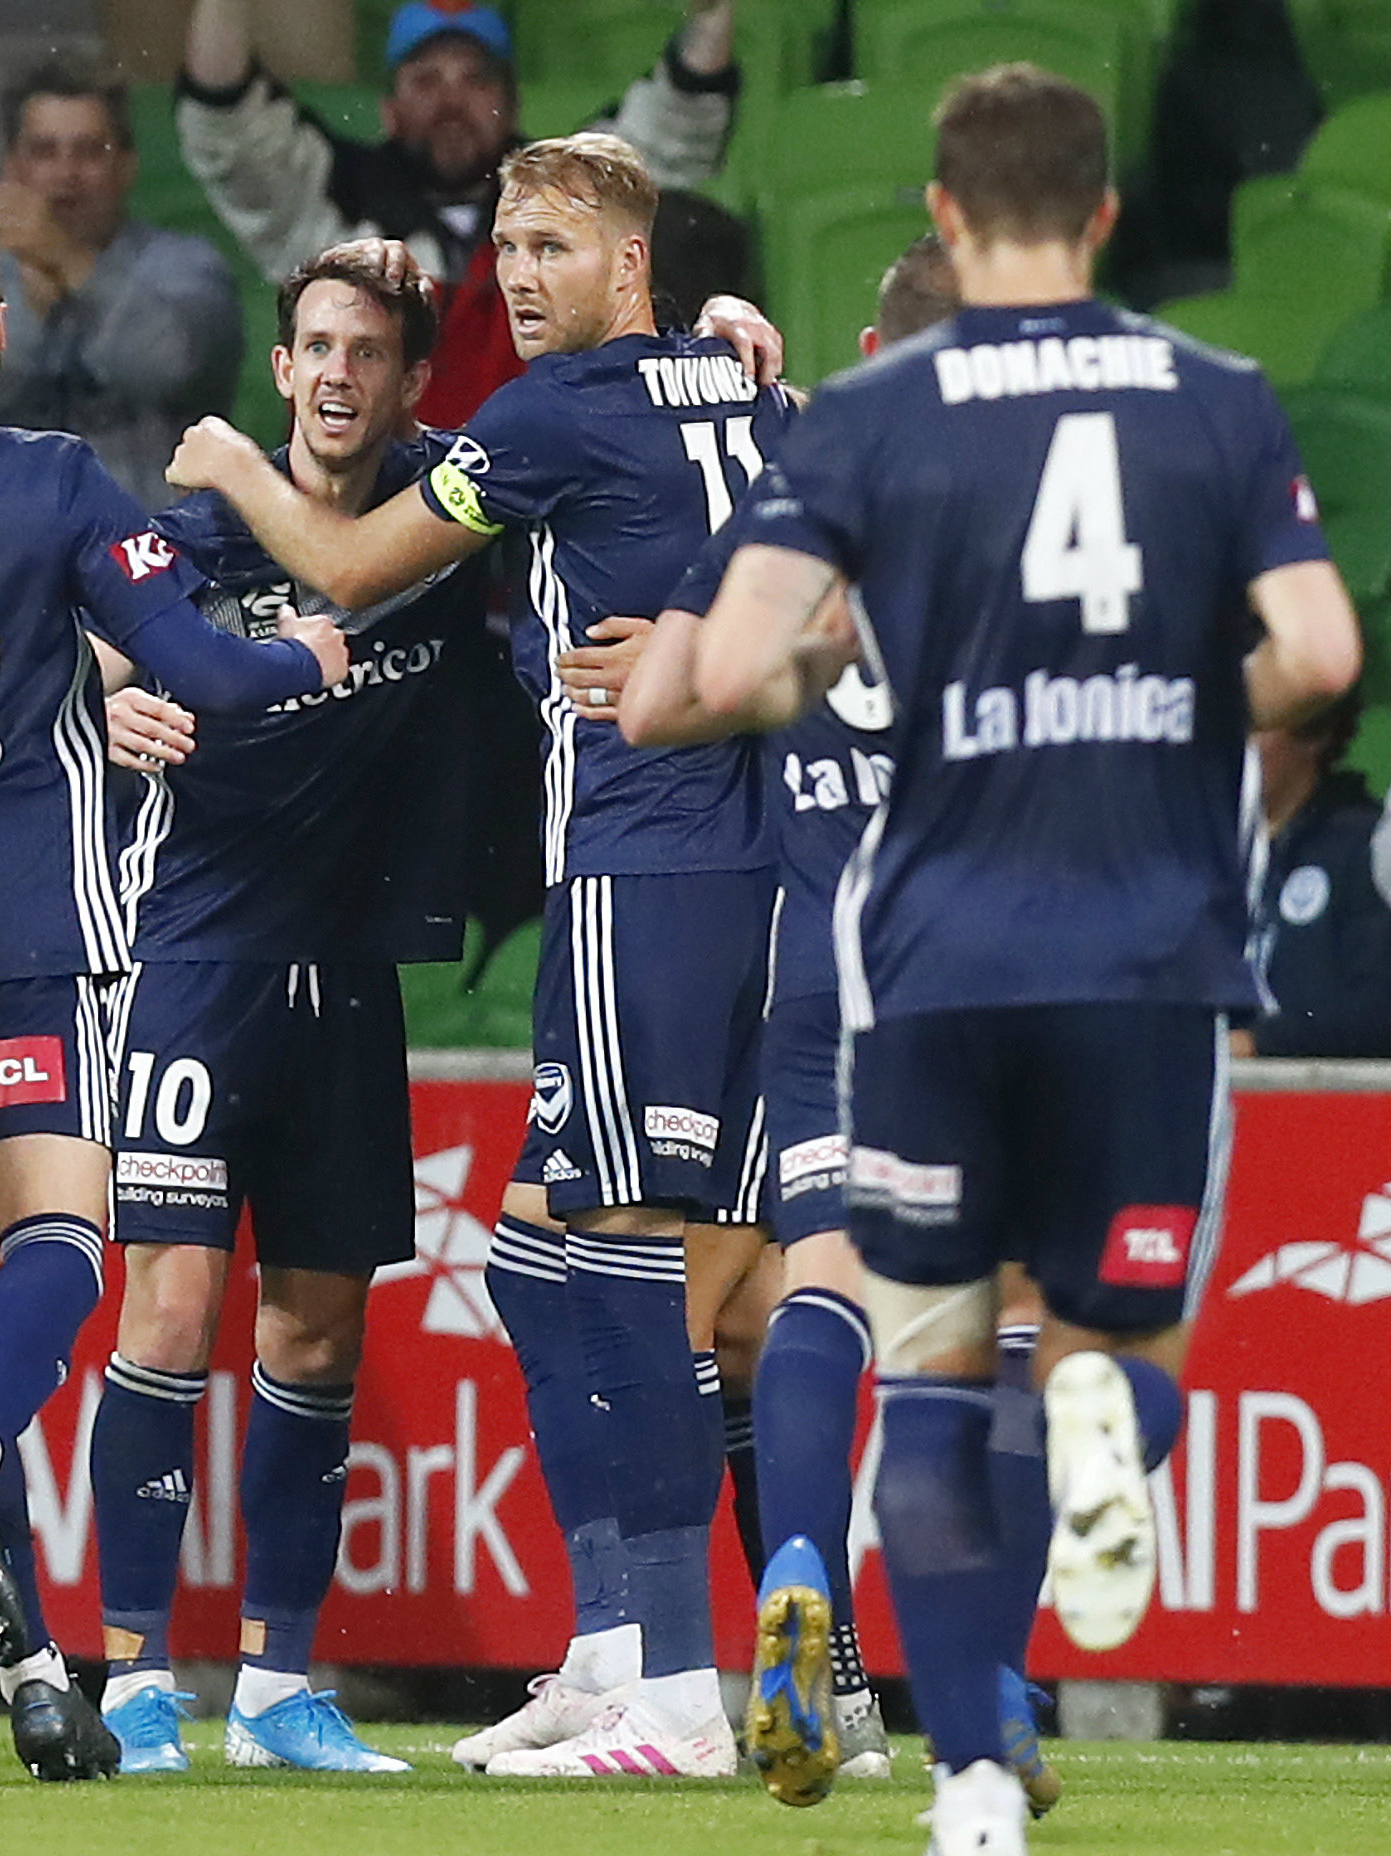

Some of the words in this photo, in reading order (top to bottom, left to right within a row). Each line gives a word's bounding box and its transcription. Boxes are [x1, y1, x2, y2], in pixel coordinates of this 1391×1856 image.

[1022, 412, 1142, 635] 4
[943, 680, 1017, 760] La
[124, 1051, 211, 1145] 10
[1123, 1228, 1183, 1263] TCL
[334, 1376, 531, 1596] ark
[1238, 1391, 1391, 1619] Pa
